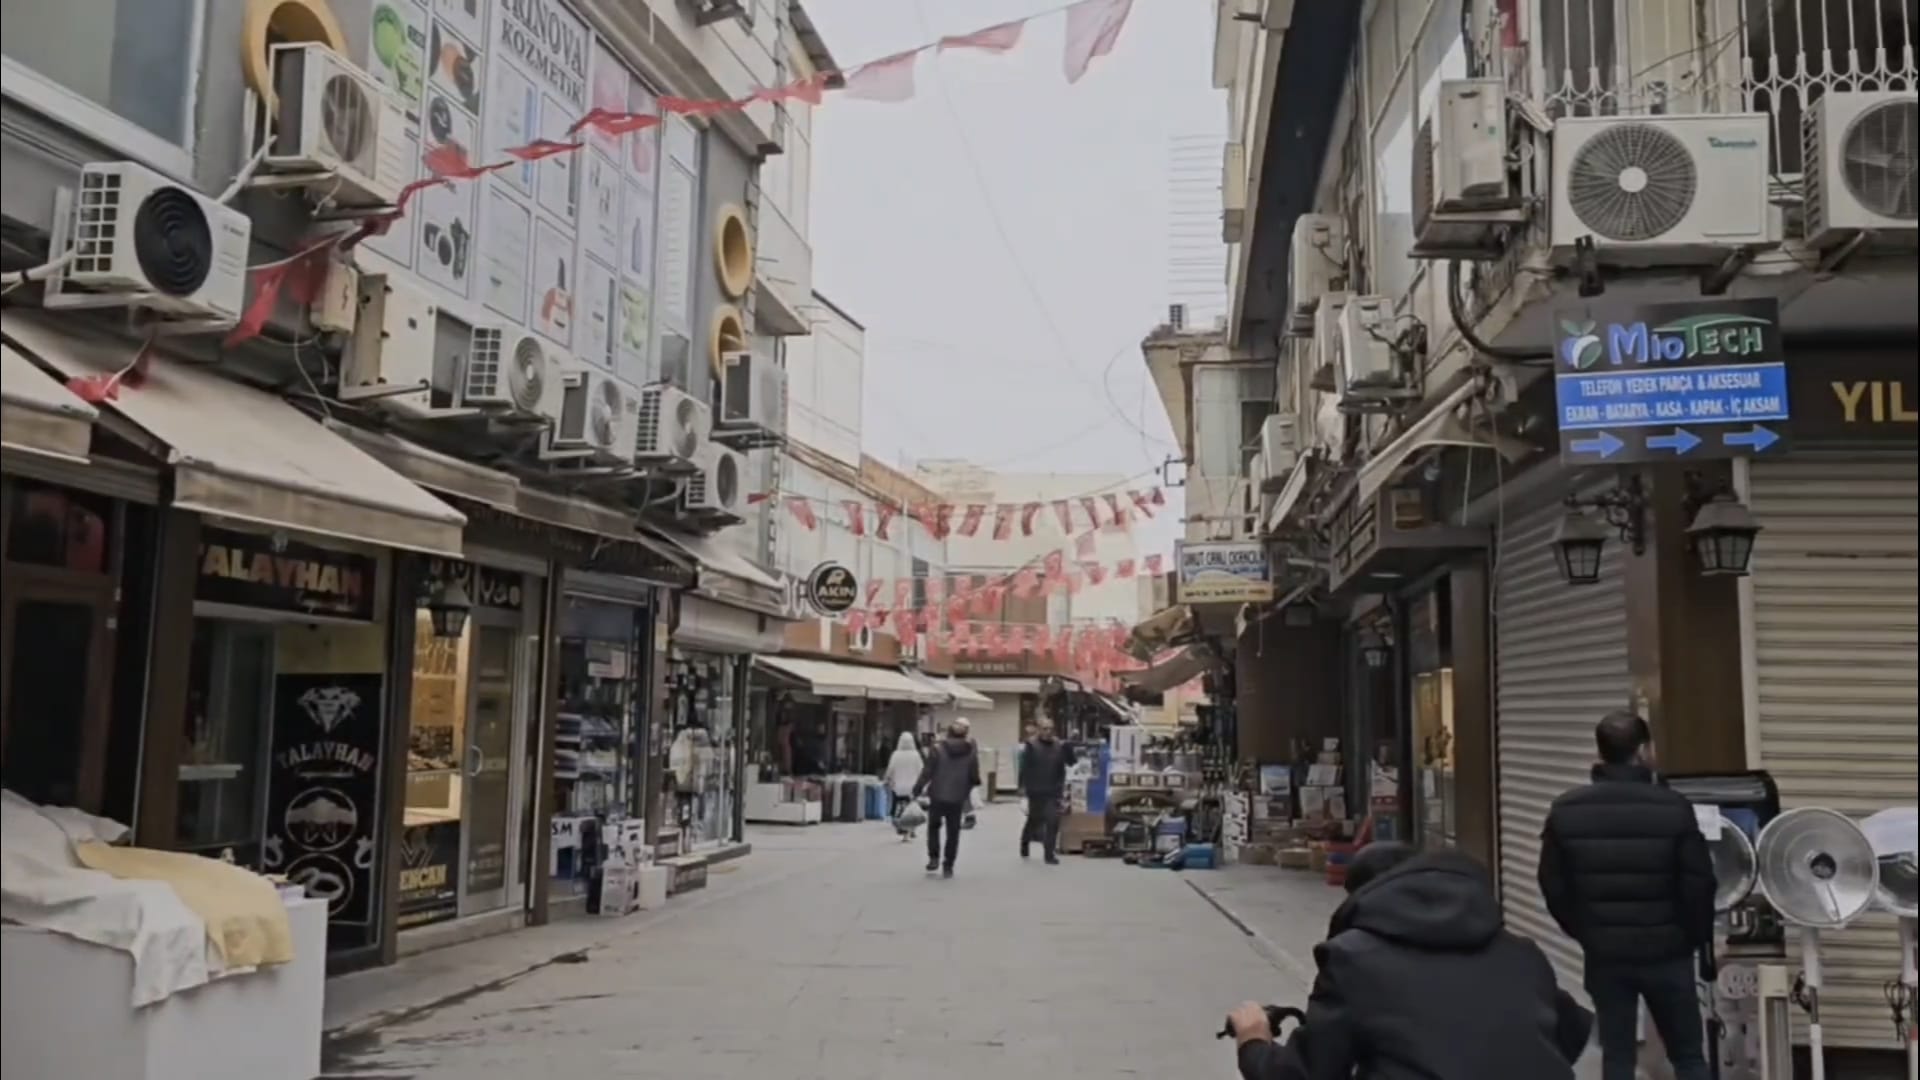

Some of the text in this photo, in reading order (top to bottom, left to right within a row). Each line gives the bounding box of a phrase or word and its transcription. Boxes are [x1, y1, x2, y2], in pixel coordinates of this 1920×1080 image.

[501, 0, 584, 79] RINOVA
[1580, 379, 1622, 396] TELEFON
[1660, 374, 1692, 395] PARÇA
[1707, 371, 1761, 390] AKSESUAR
[1566, 405, 1598, 422] EKRAN
[1656, 400, 1683, 417] KASA
[1690, 398, 1724, 416] KAPAK
[1743, 396, 1781, 414] AKSAM
[195, 543, 363, 596] ALAYHAN
